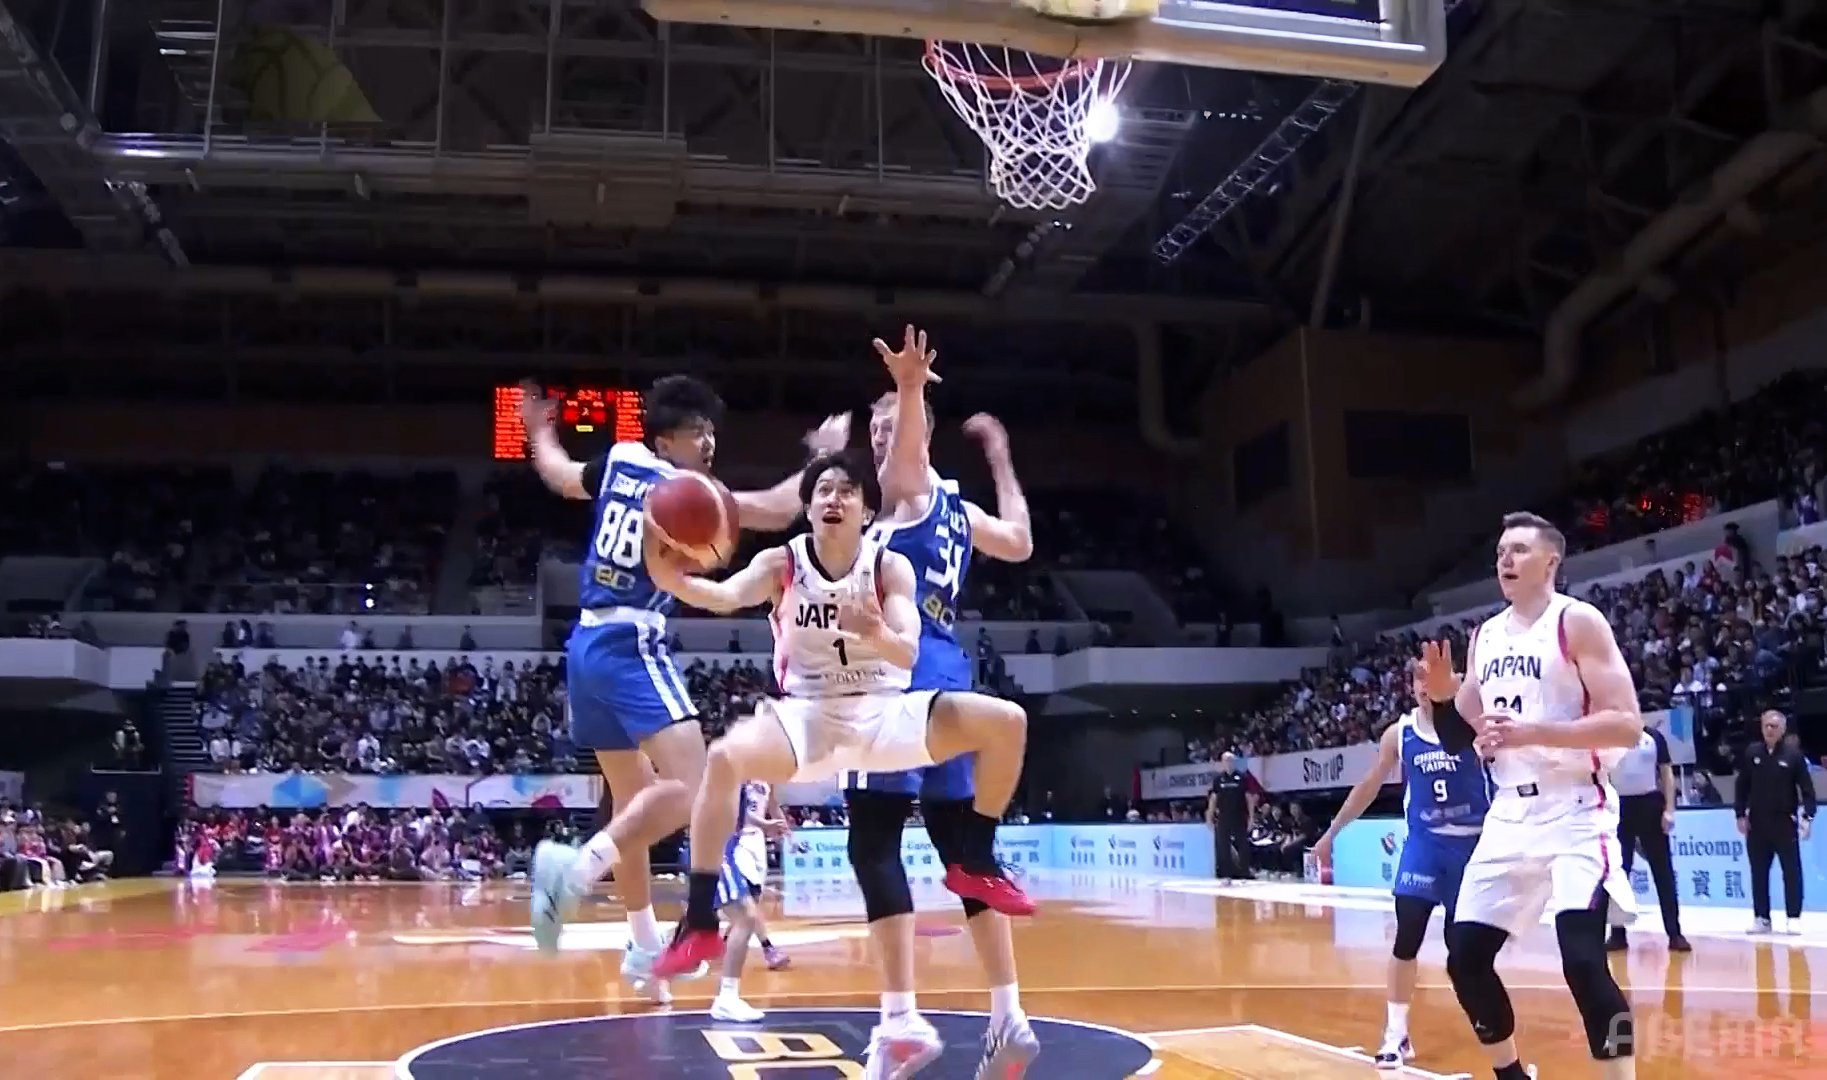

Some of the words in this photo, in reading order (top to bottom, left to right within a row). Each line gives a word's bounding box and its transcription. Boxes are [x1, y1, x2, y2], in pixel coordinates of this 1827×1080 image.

[595, 500, 643, 569] 88
[795, 603, 842, 630] JAP
[832, 637, 848, 666] 1
[1479, 655, 1542, 685] JAPAN
[1421, 761, 1457, 774] TAIPEI
[1433, 779, 1448, 802] 9
